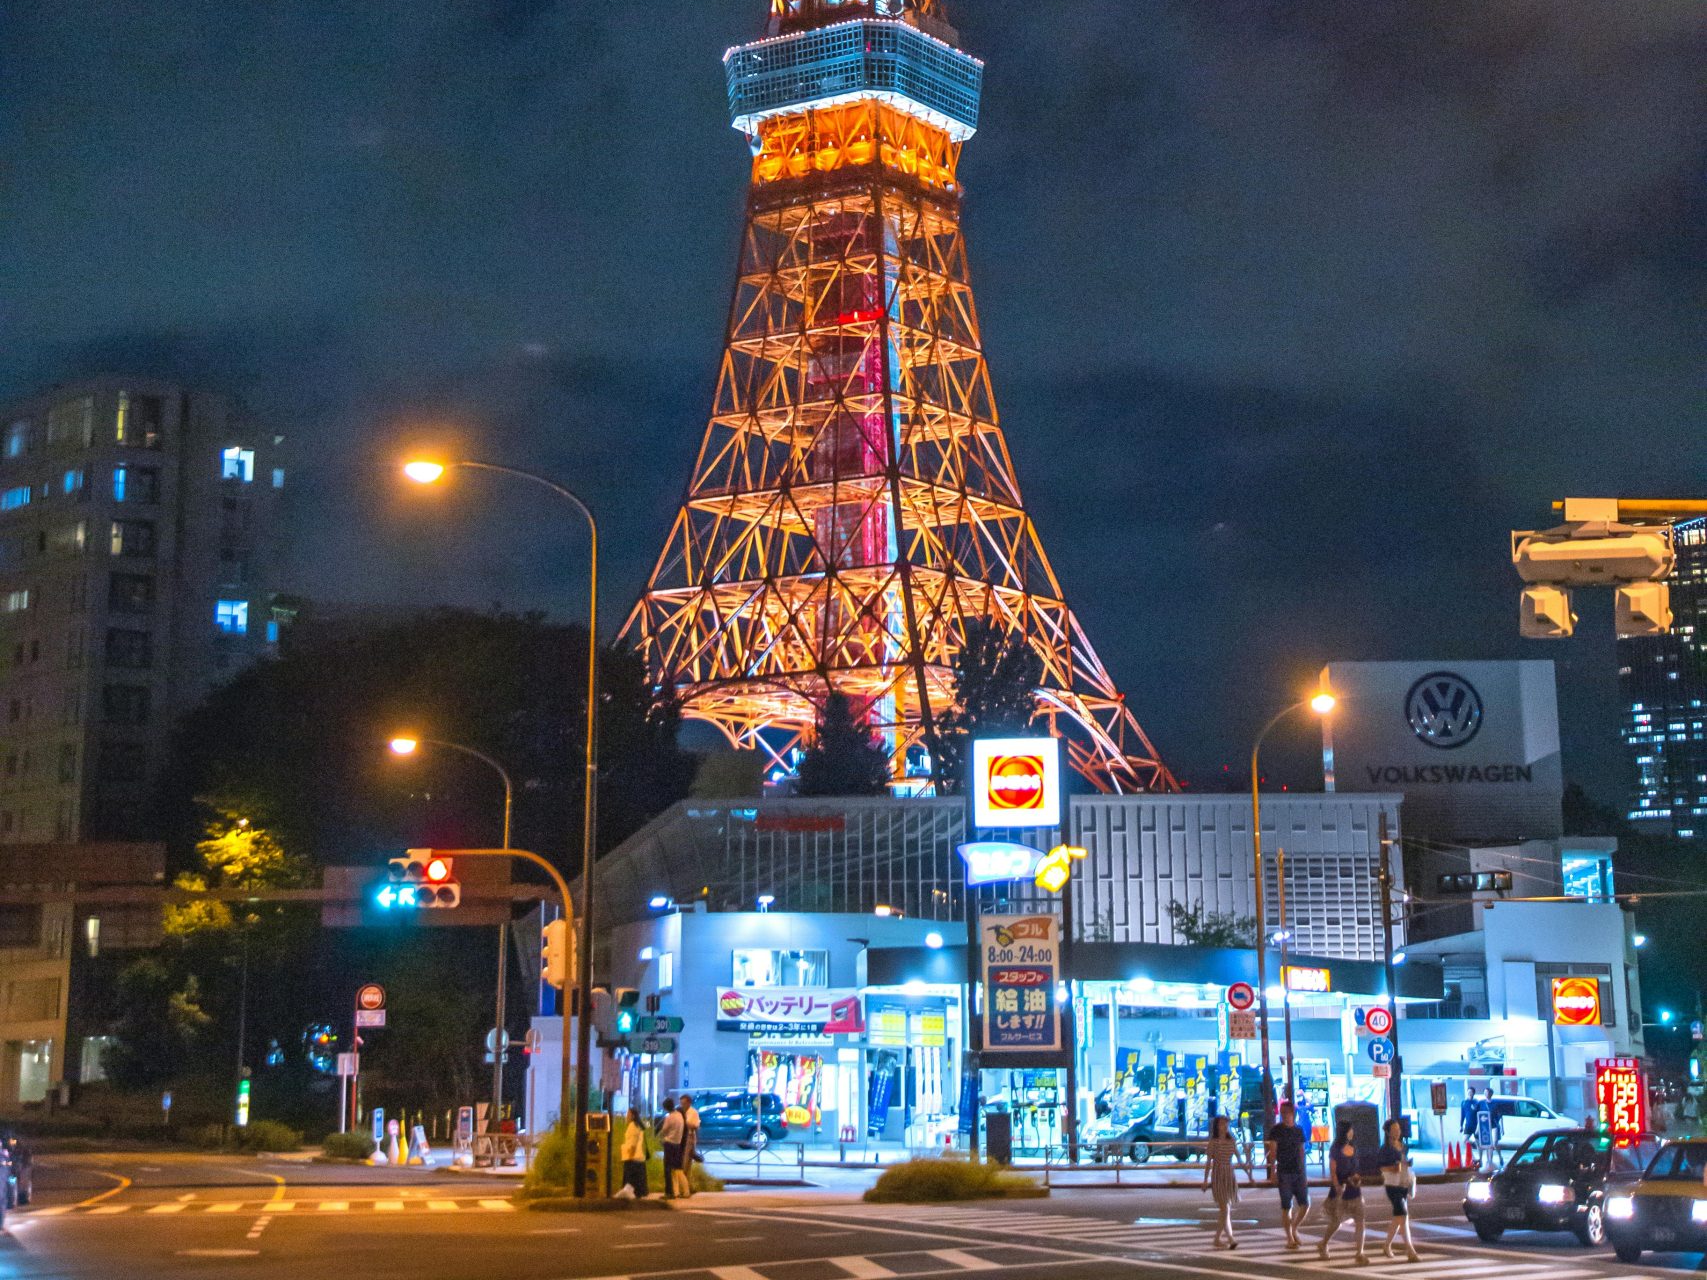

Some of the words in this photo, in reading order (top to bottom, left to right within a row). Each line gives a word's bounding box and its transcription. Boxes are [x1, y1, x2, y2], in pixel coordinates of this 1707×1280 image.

[1367, 764, 1533, 784] VOLKSWAGEN
[1017, 922, 1043, 937] フル
[999, 971, 1044, 983] スタッフが
[745, 995, 829, 1016] バッテリー
[996, 988, 1046, 1012] 給油
[655, 1019, 669, 1030] 301
[1372, 1015, 1387, 1027] 40
[1001, 1032, 1043, 1041] フルサービス
[644, 1040, 659, 1051] 319
[1613, 1083, 1638, 1104] 139
